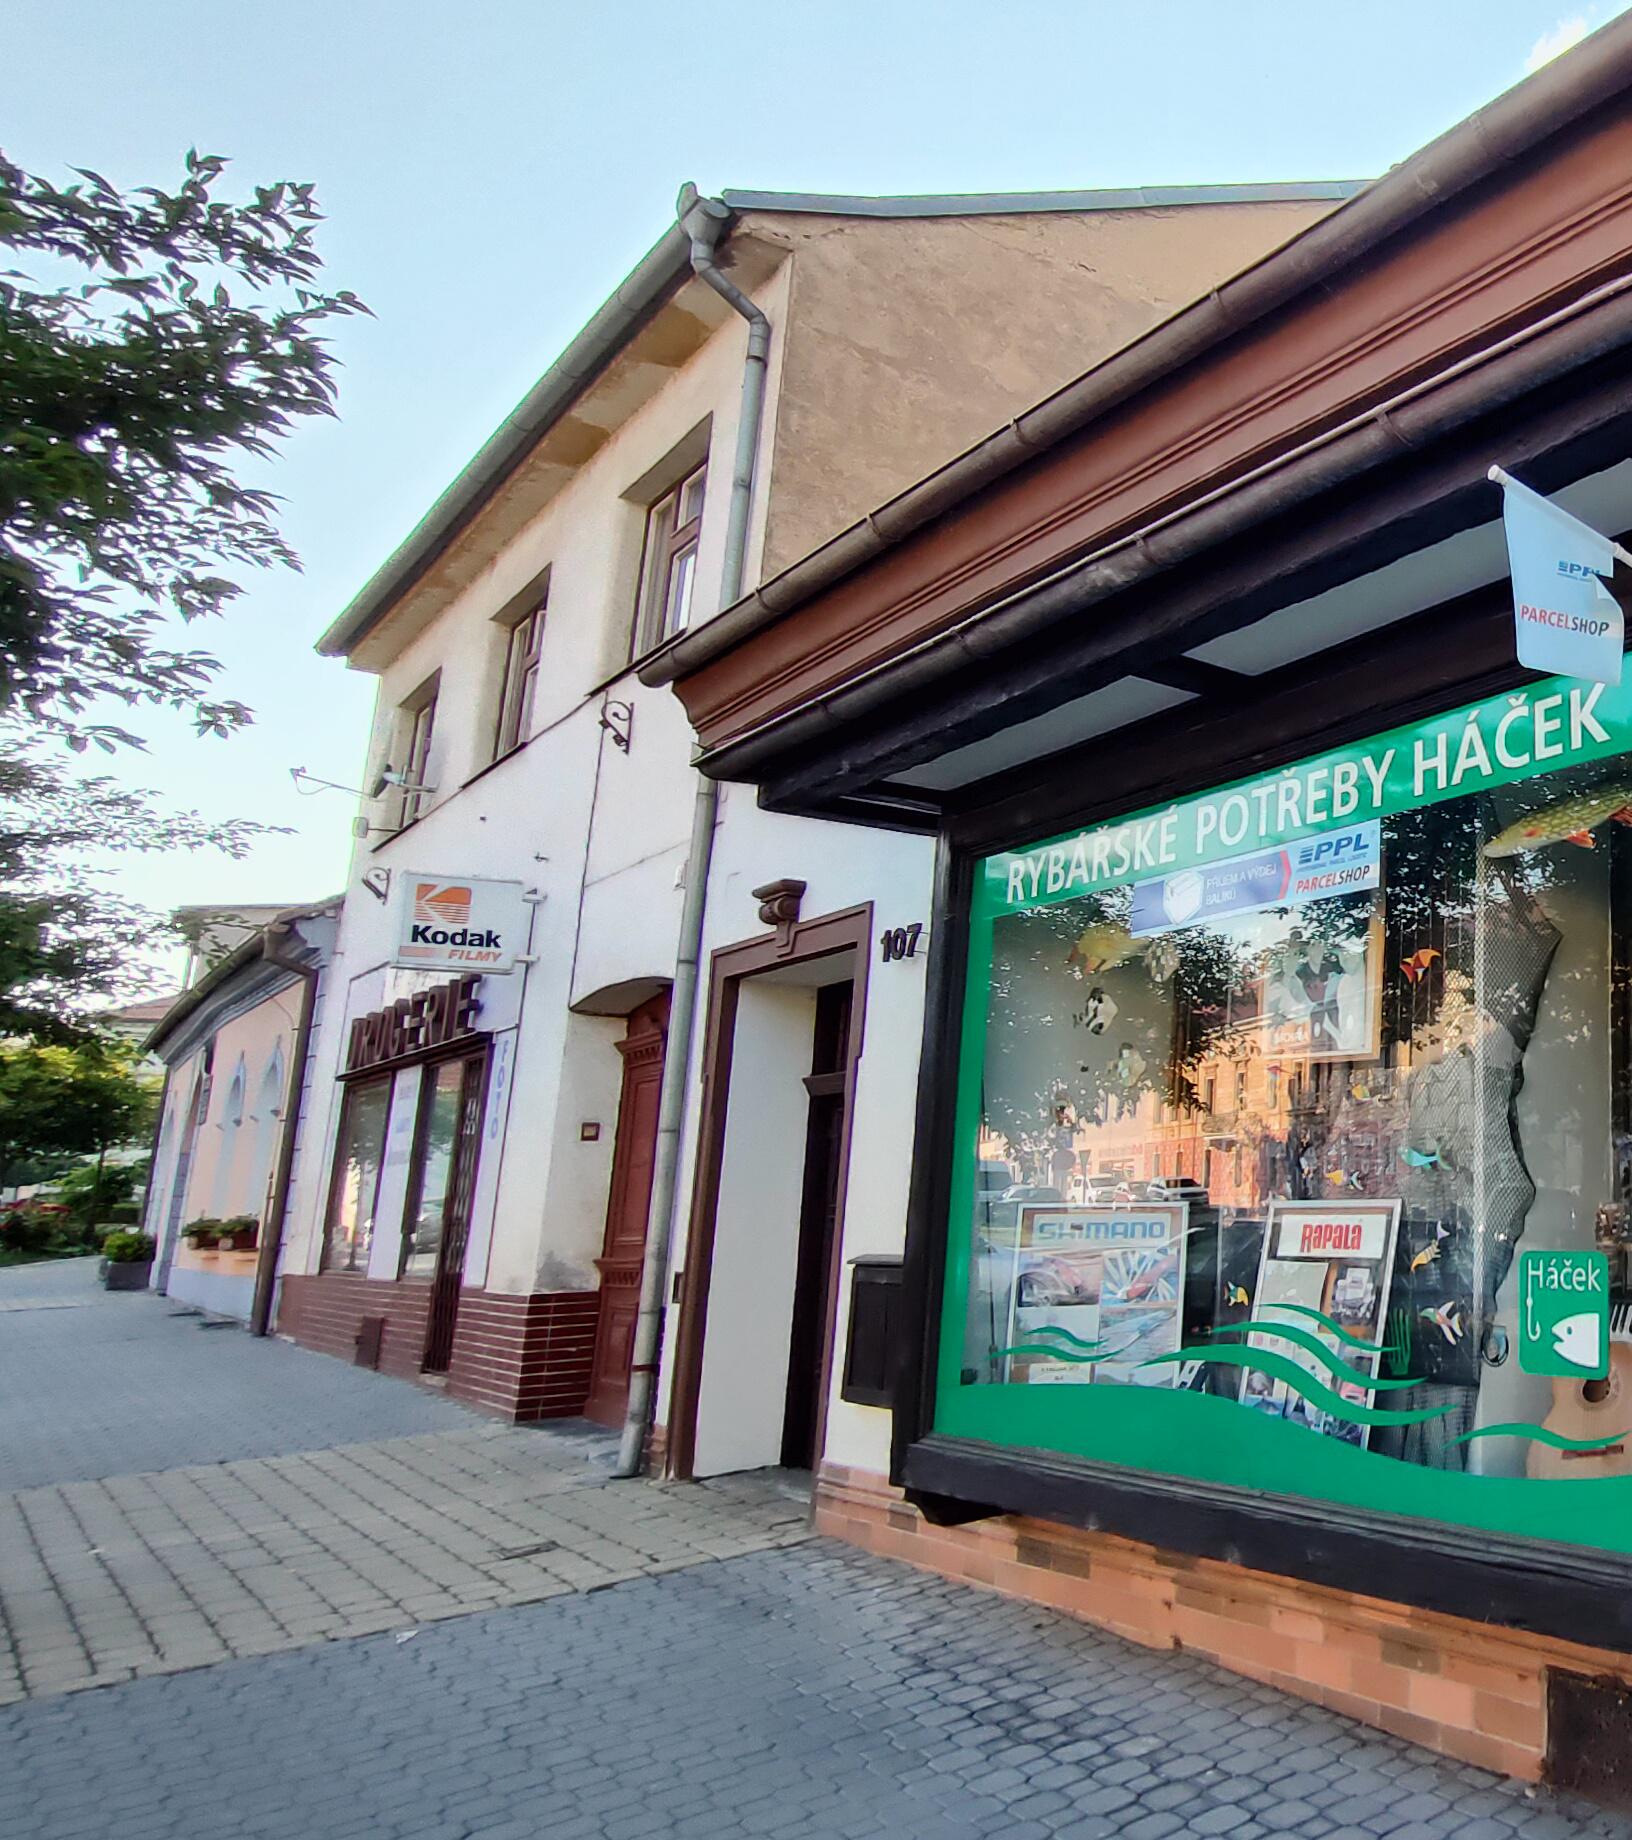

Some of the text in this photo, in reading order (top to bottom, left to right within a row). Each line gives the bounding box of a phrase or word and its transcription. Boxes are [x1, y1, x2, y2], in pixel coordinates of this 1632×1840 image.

[1520, 603, 1610, 637] PARCELSHOP
[1005, 682, 1613, 904] RYBÁŘSKÉ POTŘEBY HÁČEK
[1313, 833, 1370, 862] PPL
[1296, 865, 1370, 895] PARCELSHOP
[411, 925, 502, 949] Kodak
[880, 923, 922, 962] 107
[448, 950, 502, 963] FILMY
[1038, 1221, 1165, 1240] SHIMANO
[1526, 1257, 1602, 1292] Háček
